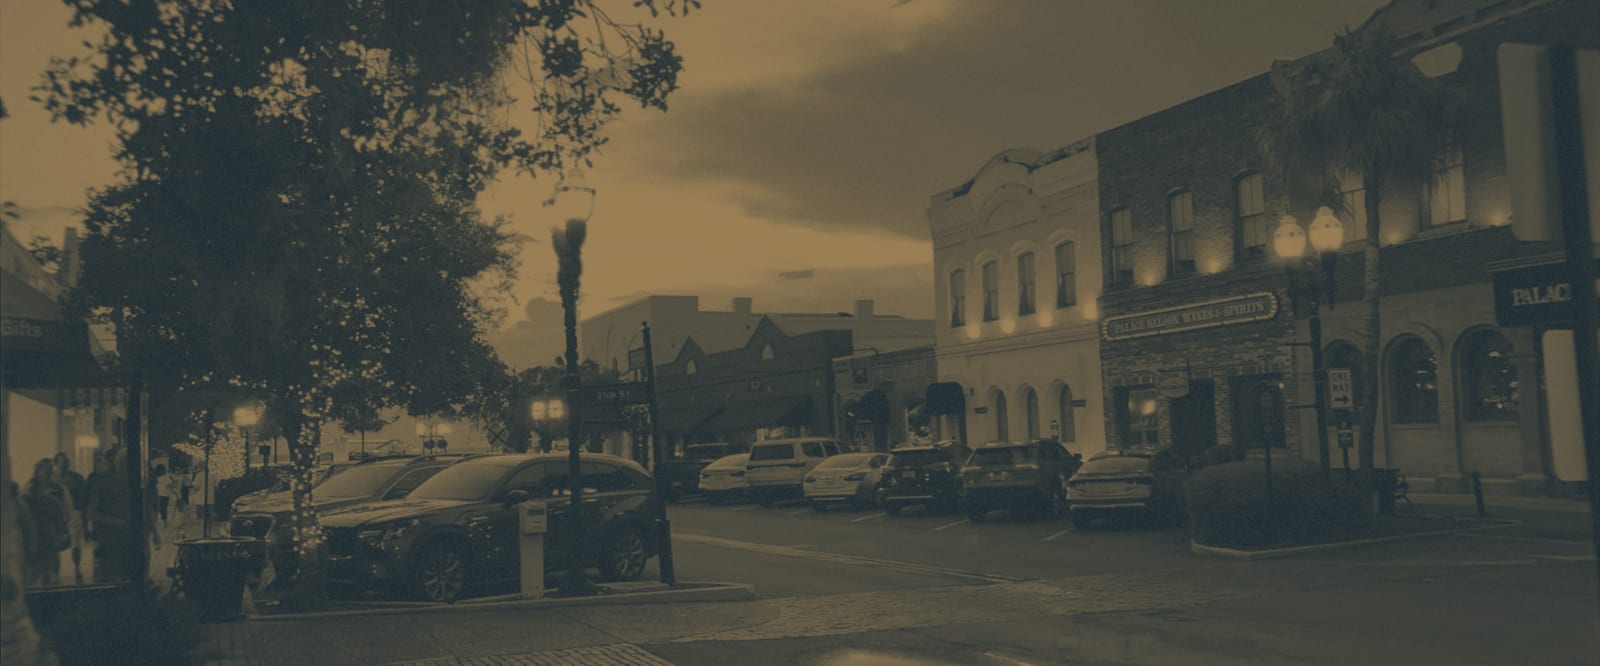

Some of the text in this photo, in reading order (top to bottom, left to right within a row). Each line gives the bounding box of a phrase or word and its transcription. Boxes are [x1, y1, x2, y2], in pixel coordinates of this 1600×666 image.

[1114, 320, 1145, 333] PALACE
[1182, 311, 1213, 323] WINES
[1223, 301, 1264, 317] SPIRITS
[1331, 373, 1348, 382] ONE
[1332, 384, 1349, 392] WAY
[618, 389, 632, 400] ST
